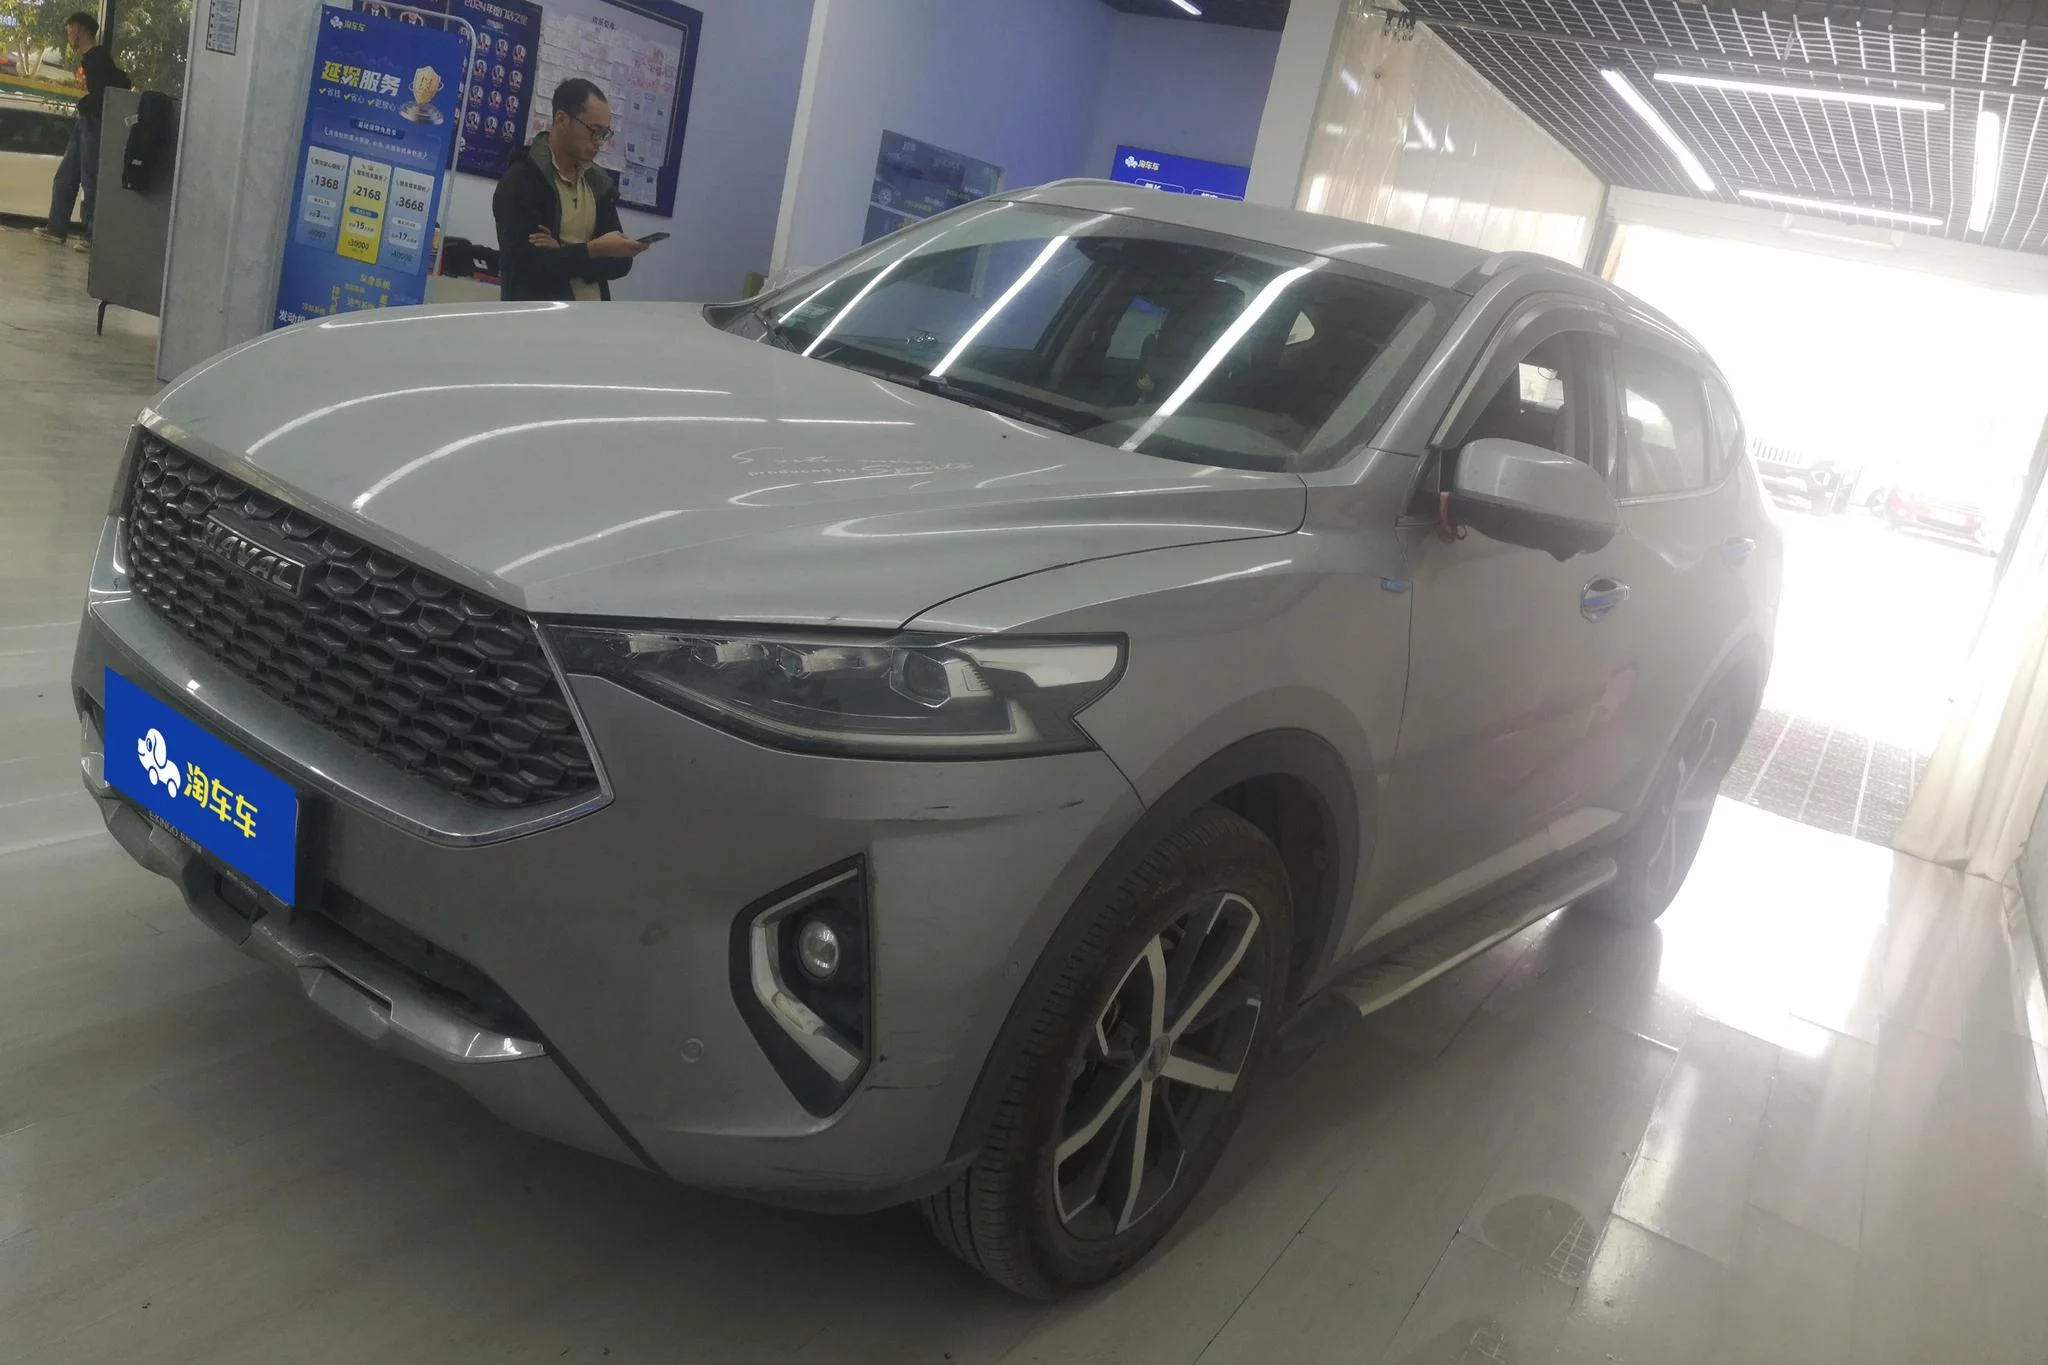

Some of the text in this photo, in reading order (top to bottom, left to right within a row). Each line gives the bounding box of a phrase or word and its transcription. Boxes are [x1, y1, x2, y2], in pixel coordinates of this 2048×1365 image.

[321, 61, 401, 96] 延保服务
[205, 521, 293, 590] HAVAL
